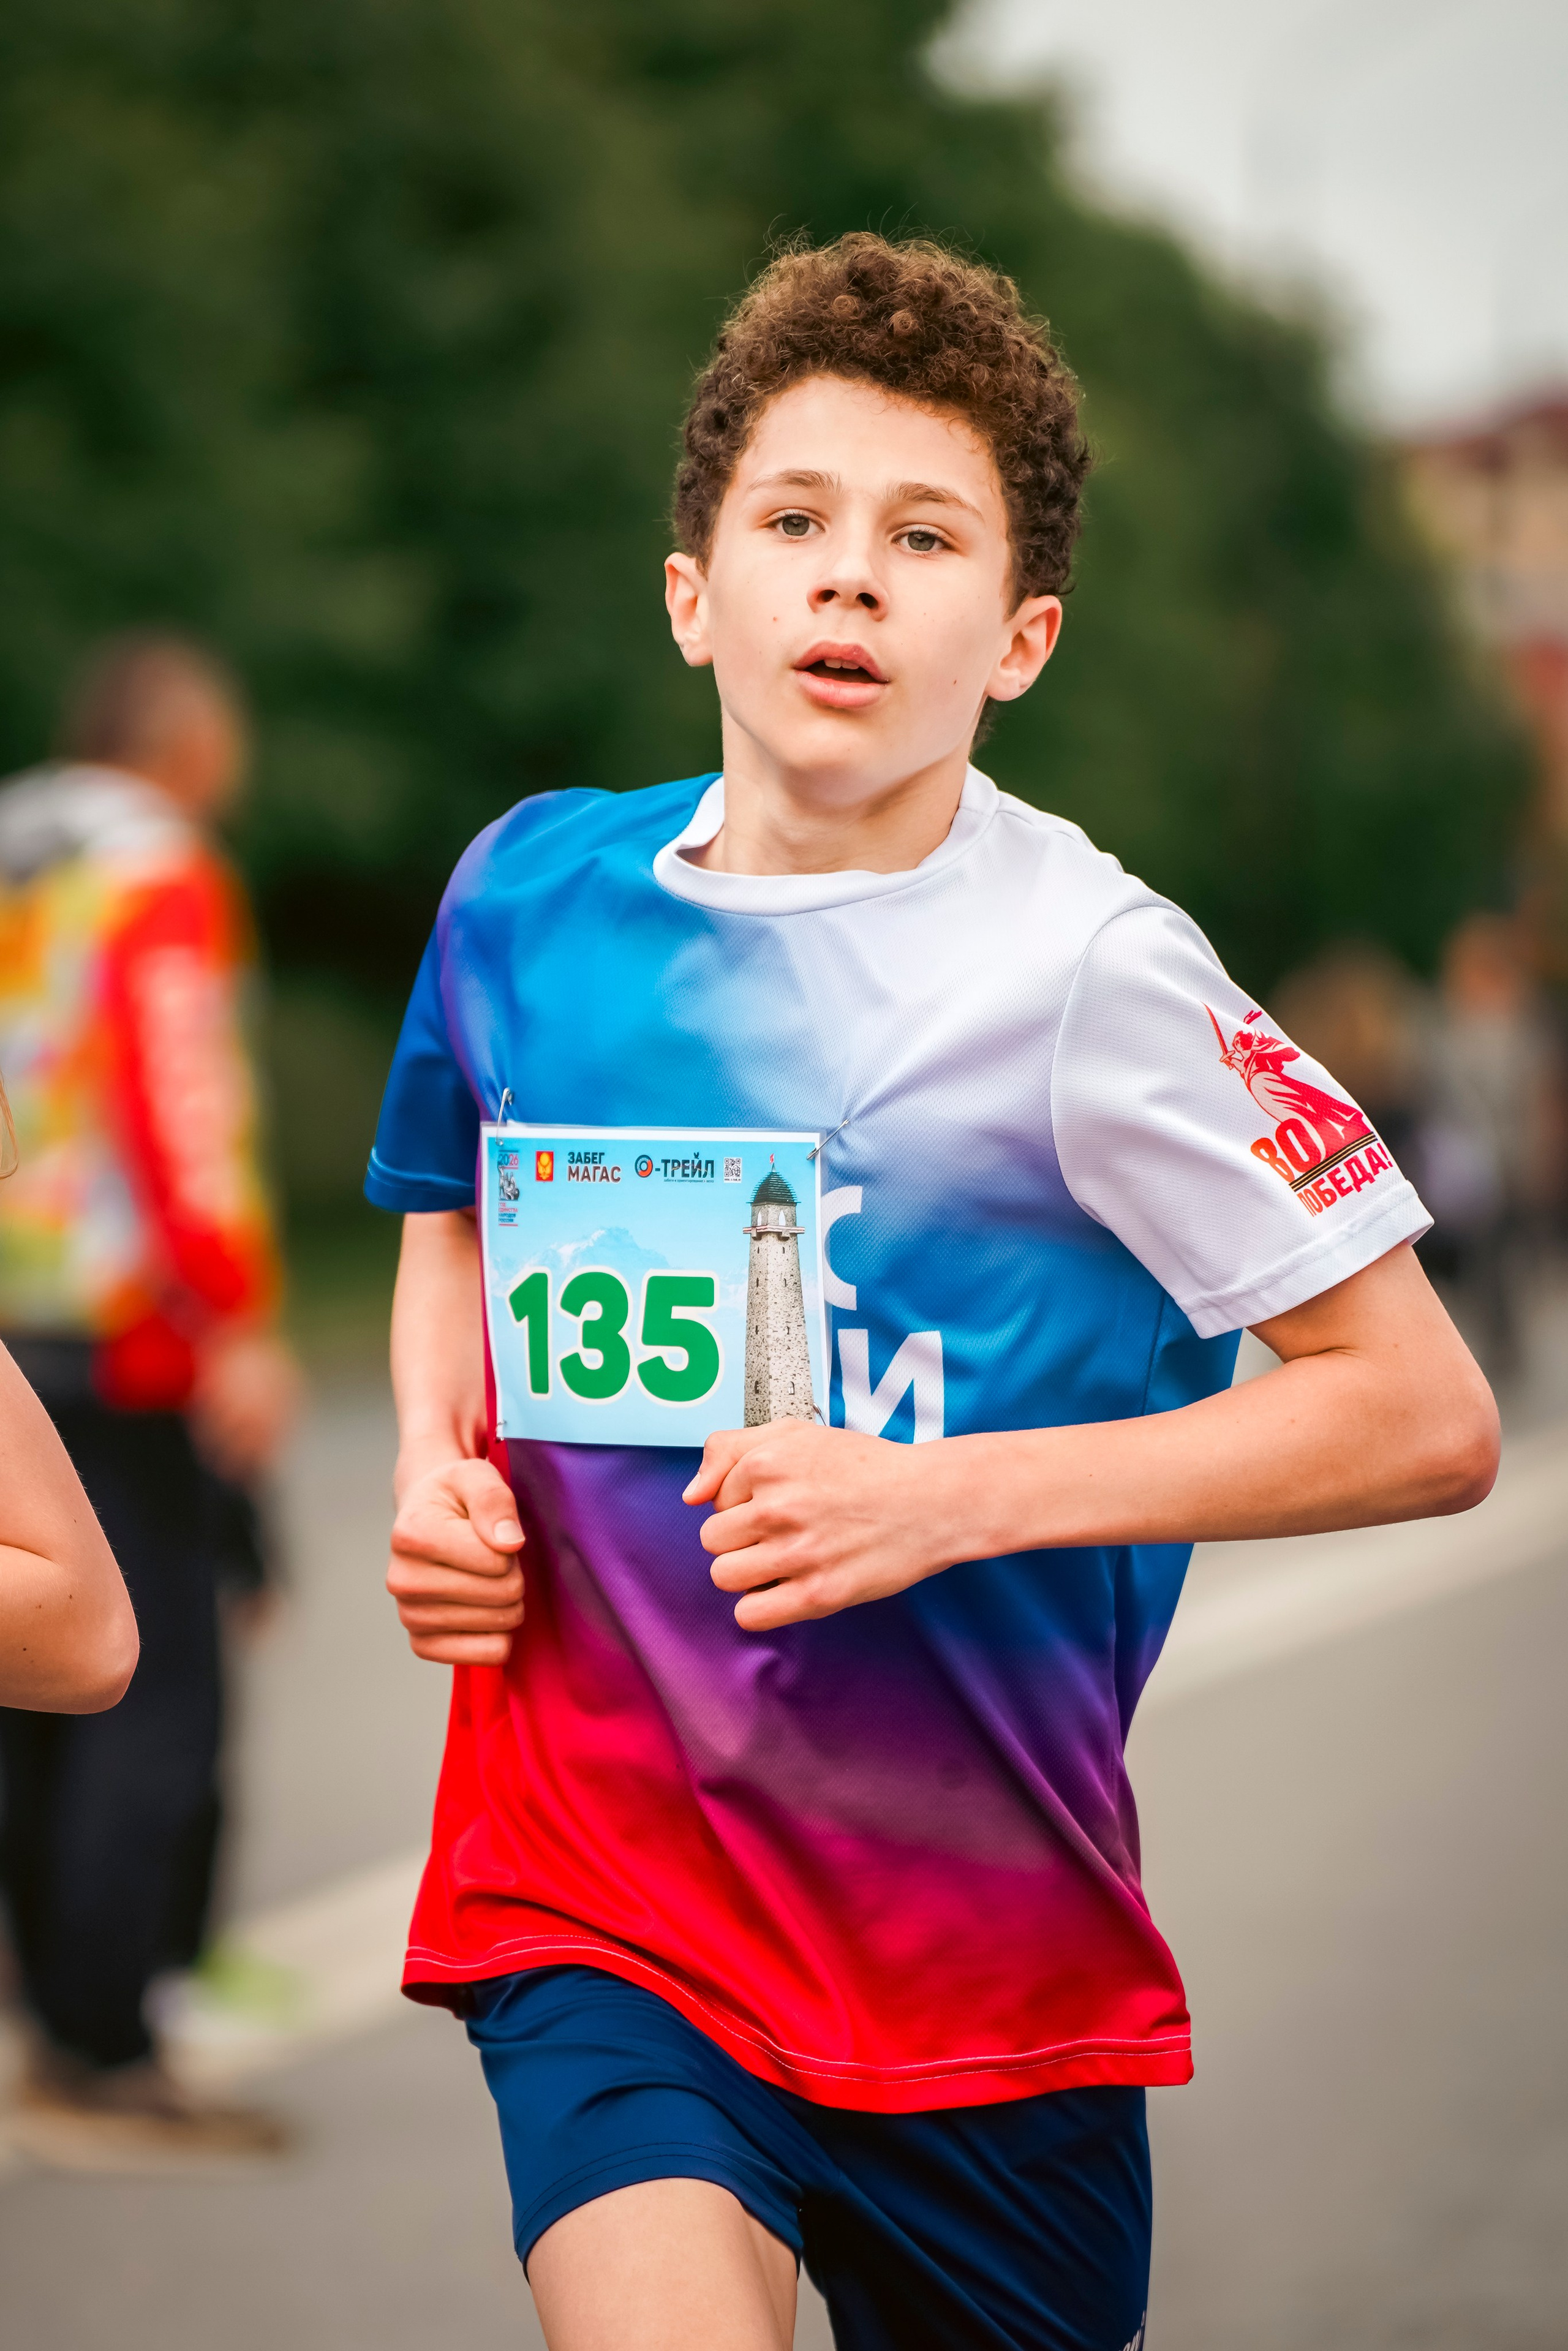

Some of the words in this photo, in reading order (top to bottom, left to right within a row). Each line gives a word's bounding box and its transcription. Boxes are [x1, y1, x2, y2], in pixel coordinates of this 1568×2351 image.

[567, 1152, 605, 1164] ЗАБЕГ
[567, 1165, 621, 1183] МАГАС
[1251, 1118, 1322, 1182] 80
[1296, 1142, 1393, 1217] ПОБЕДА!
[508, 1271, 720, 1402] 135
